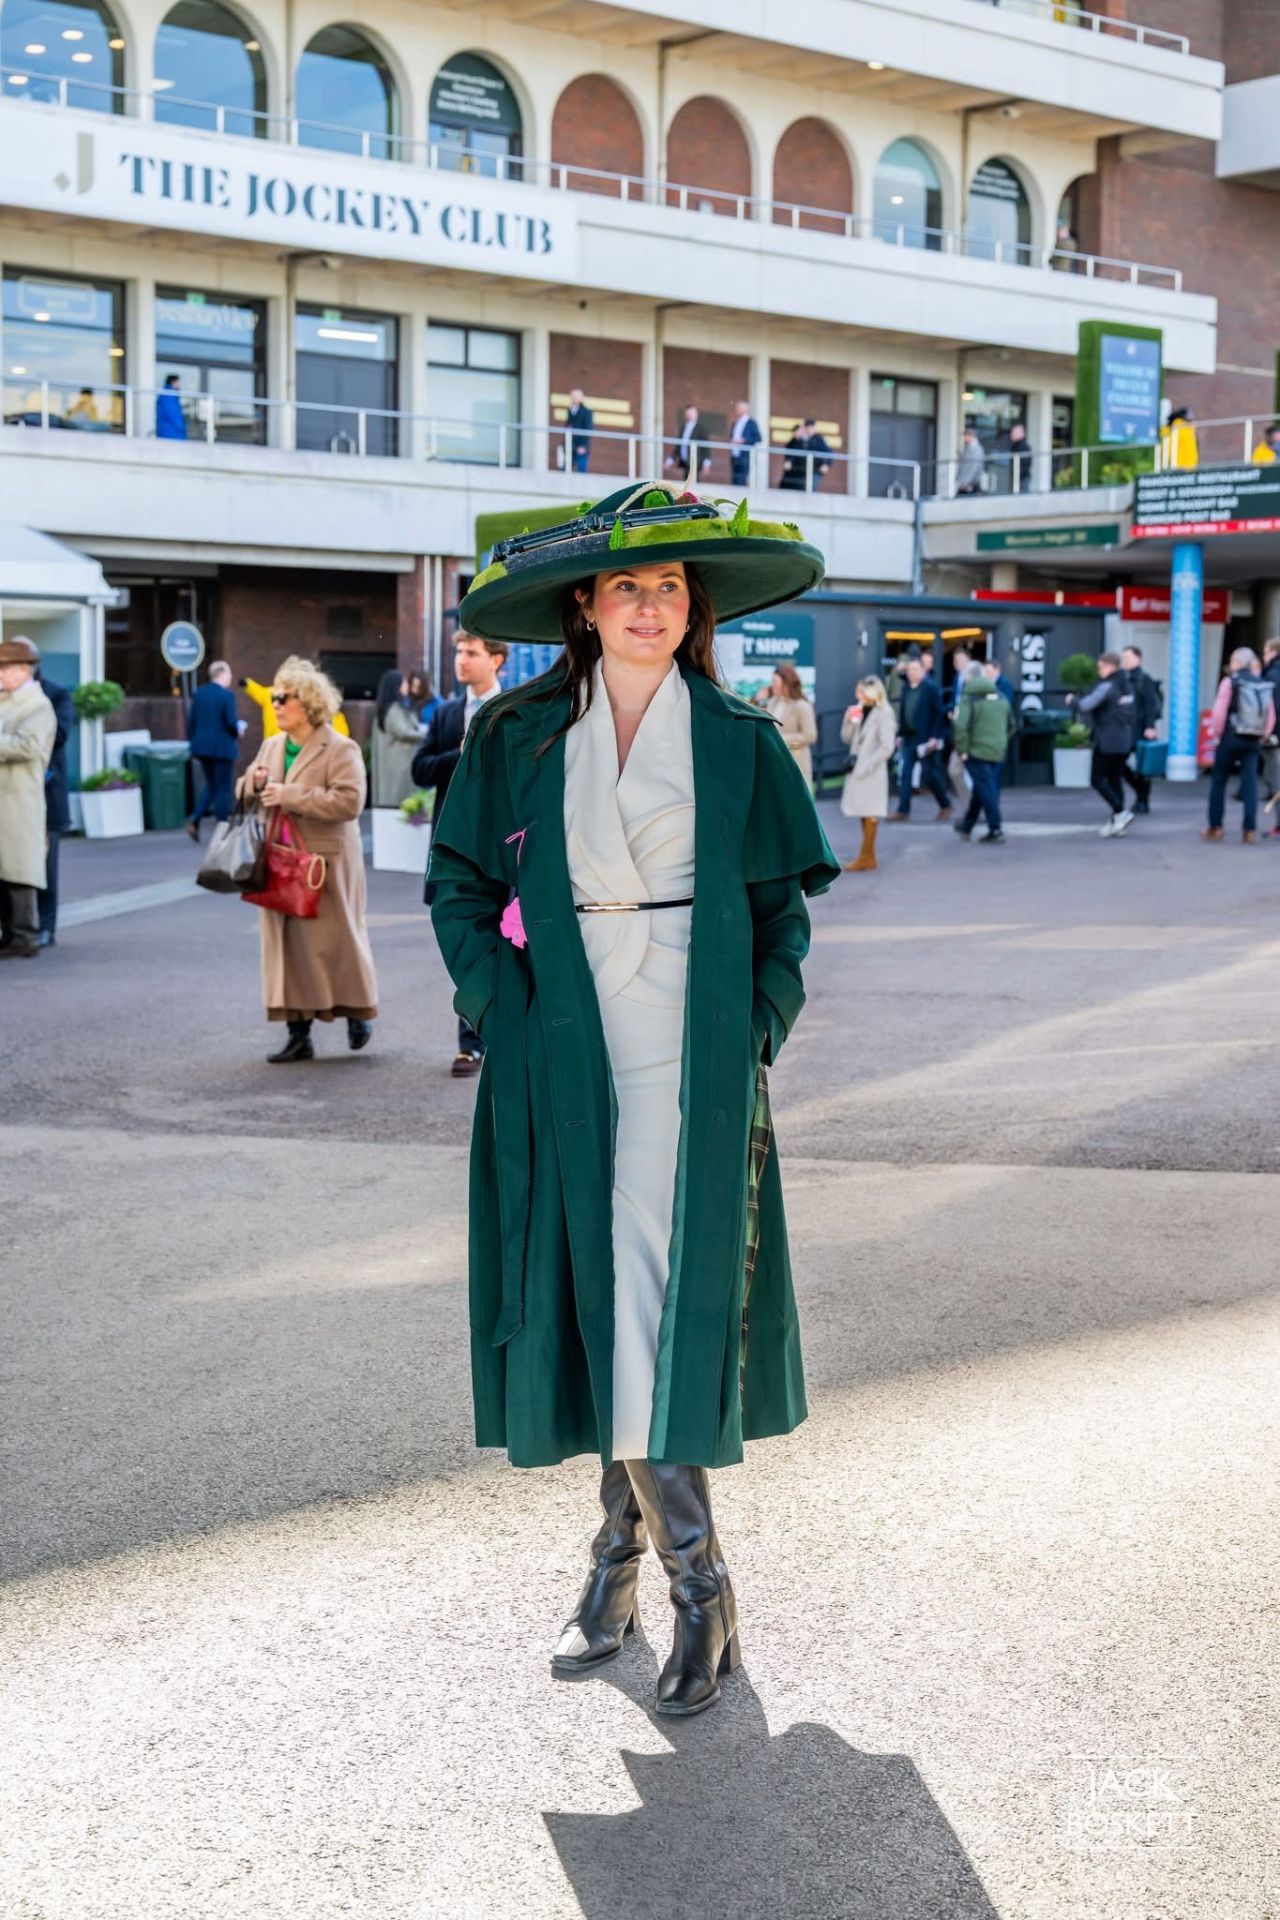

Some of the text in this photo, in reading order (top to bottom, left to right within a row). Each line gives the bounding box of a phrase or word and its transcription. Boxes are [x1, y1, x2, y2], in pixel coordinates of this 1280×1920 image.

[120, 153, 554, 256] THE JOCKEY CLUB
[1197, 469, 1261, 484] RESTAURANT
[755, 638, 800, 655] SHOP
